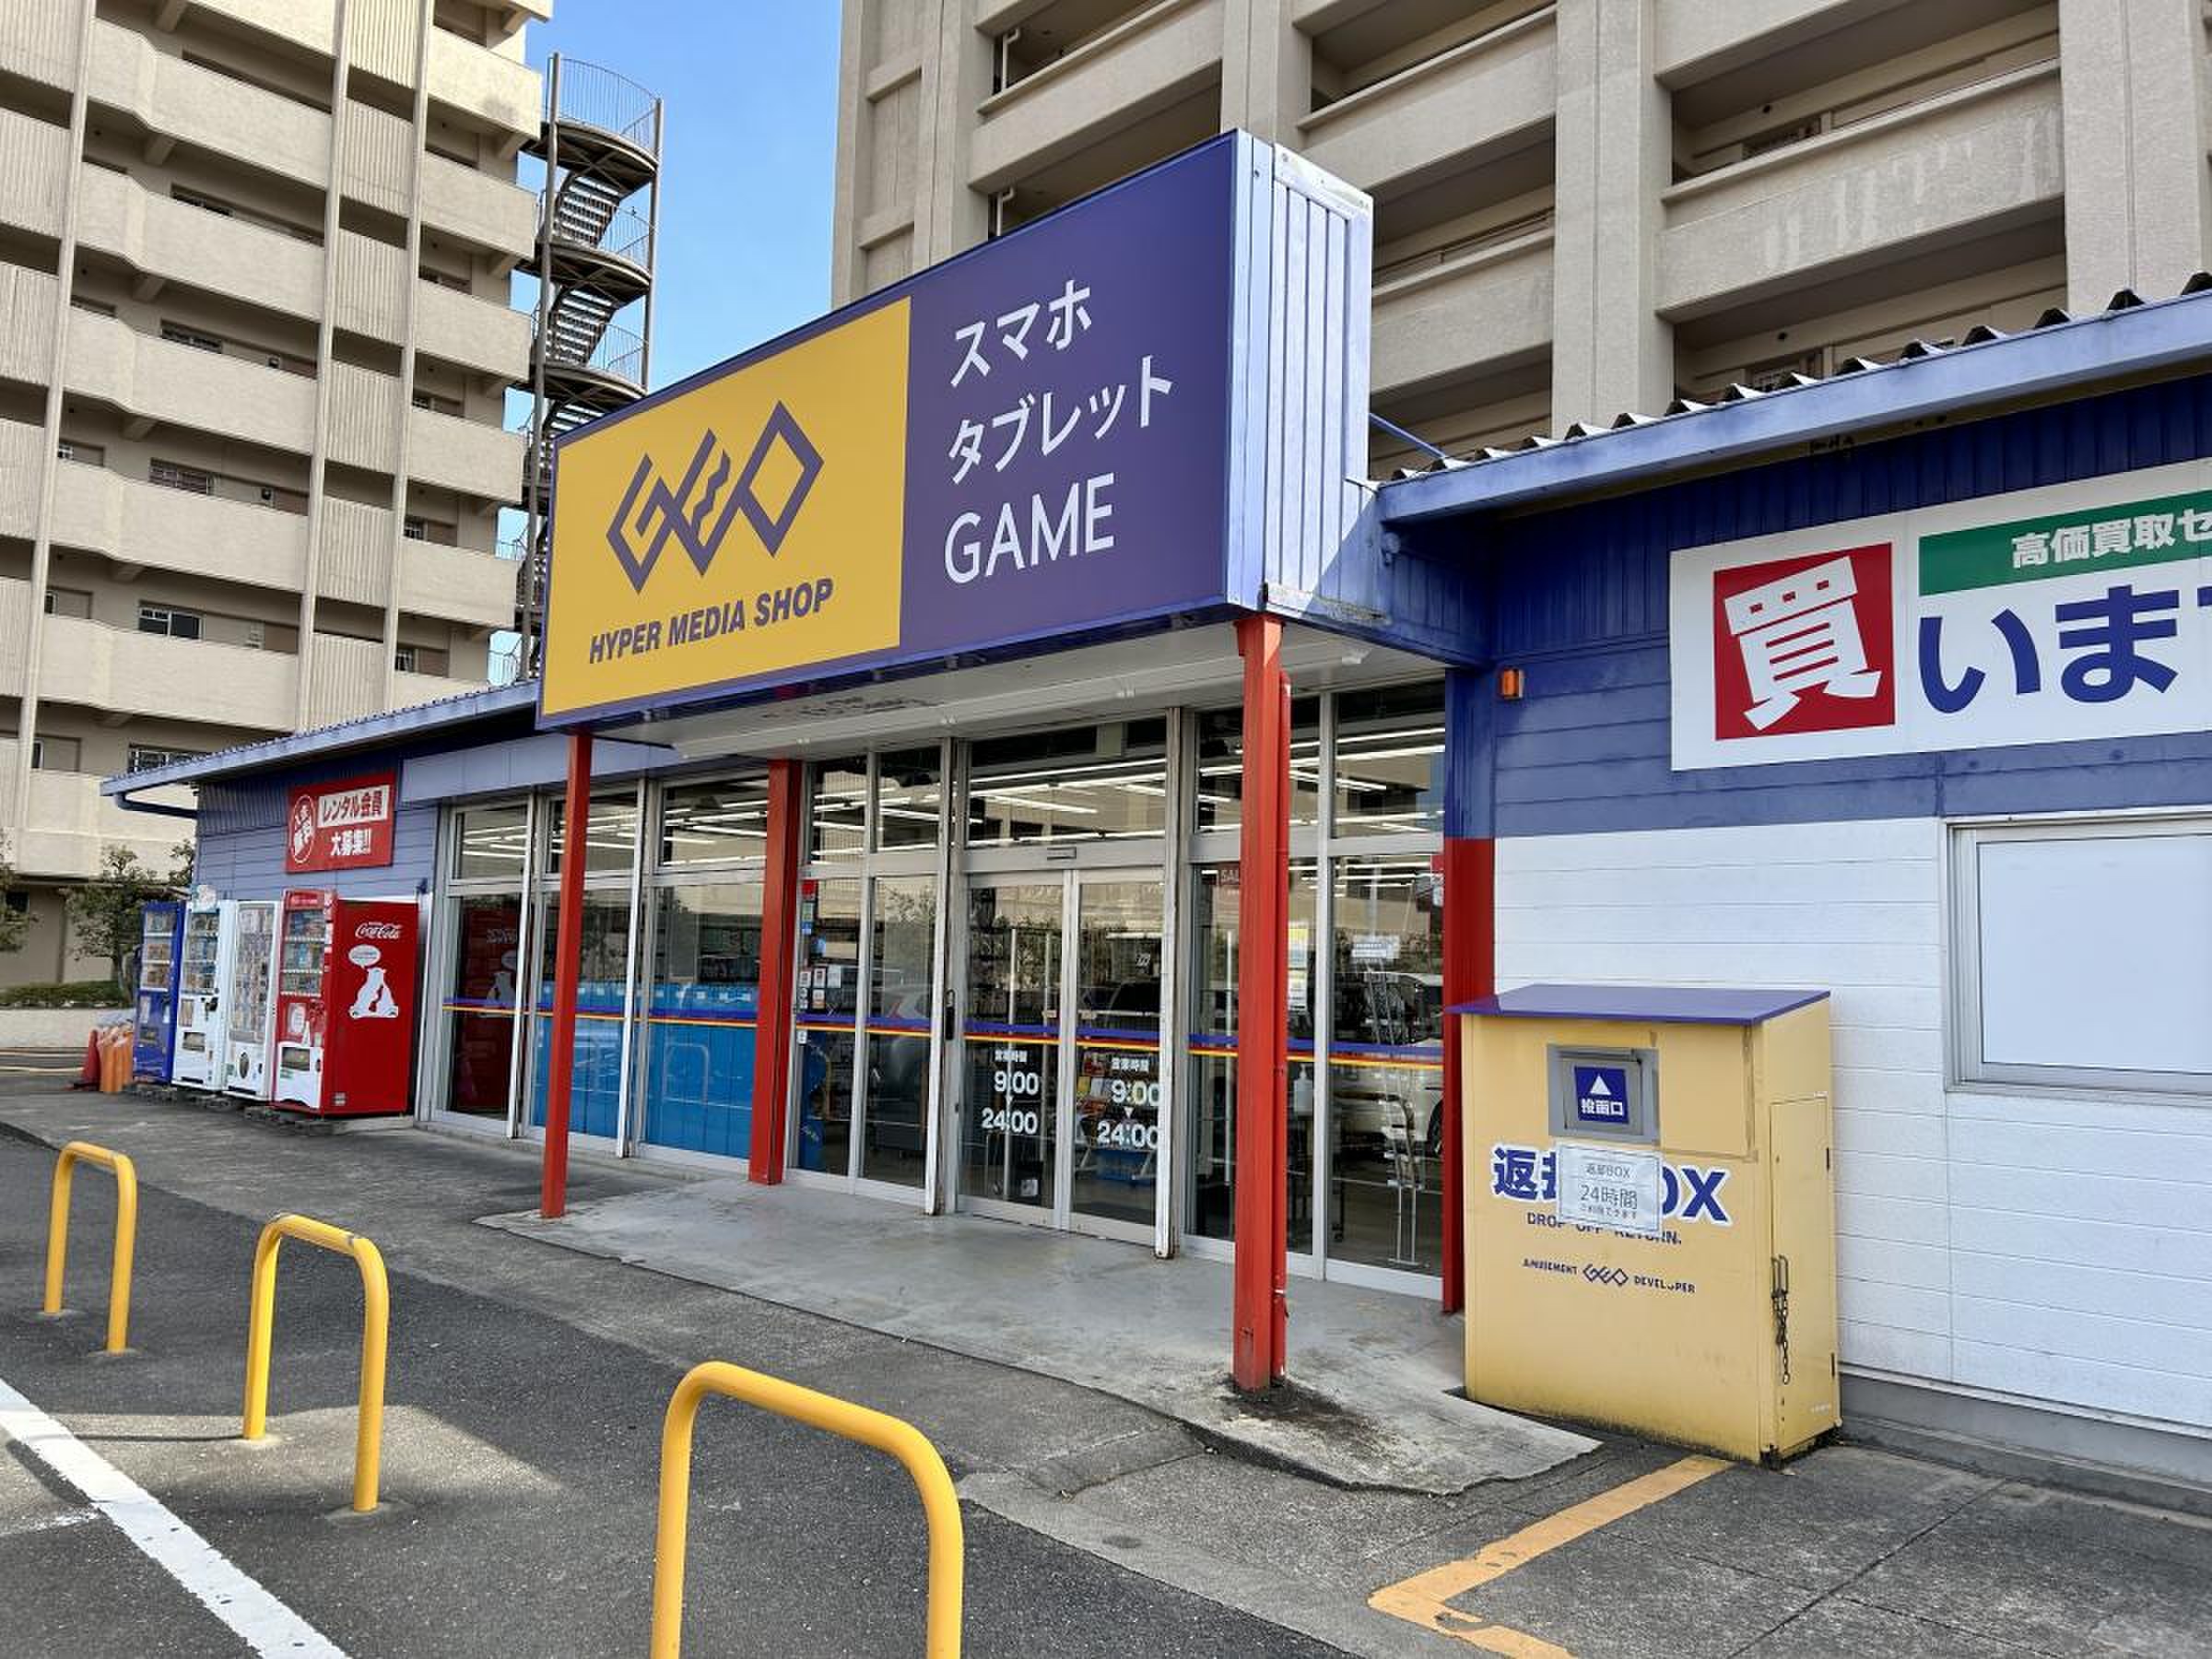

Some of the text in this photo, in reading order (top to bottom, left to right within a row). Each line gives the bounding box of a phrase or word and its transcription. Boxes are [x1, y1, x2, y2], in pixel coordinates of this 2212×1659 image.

[950, 279, 1093, 388] スマホ
[948, 354, 1173, 485] タブレット
[606, 399, 825, 595] GEO
[944, 472, 1116, 584] GAME
[2011, 508, 2212, 569] 高価買取セ
[589, 576, 834, 665] HYPER MEDIA SHOP
[1724, 555, 1882, 731] 買
[1918, 584, 2212, 714] いま
[323, 790, 383, 822] レンタル会員
[1112, 1078, 1162, 1106] 9:00
[1097, 1120, 1159, 1149] 24:00
[1527, 1212, 1566, 1229] DRO
[1580, 1184, 1637, 1209] 24時間
[1583, 1264, 1629, 1287] GEO
